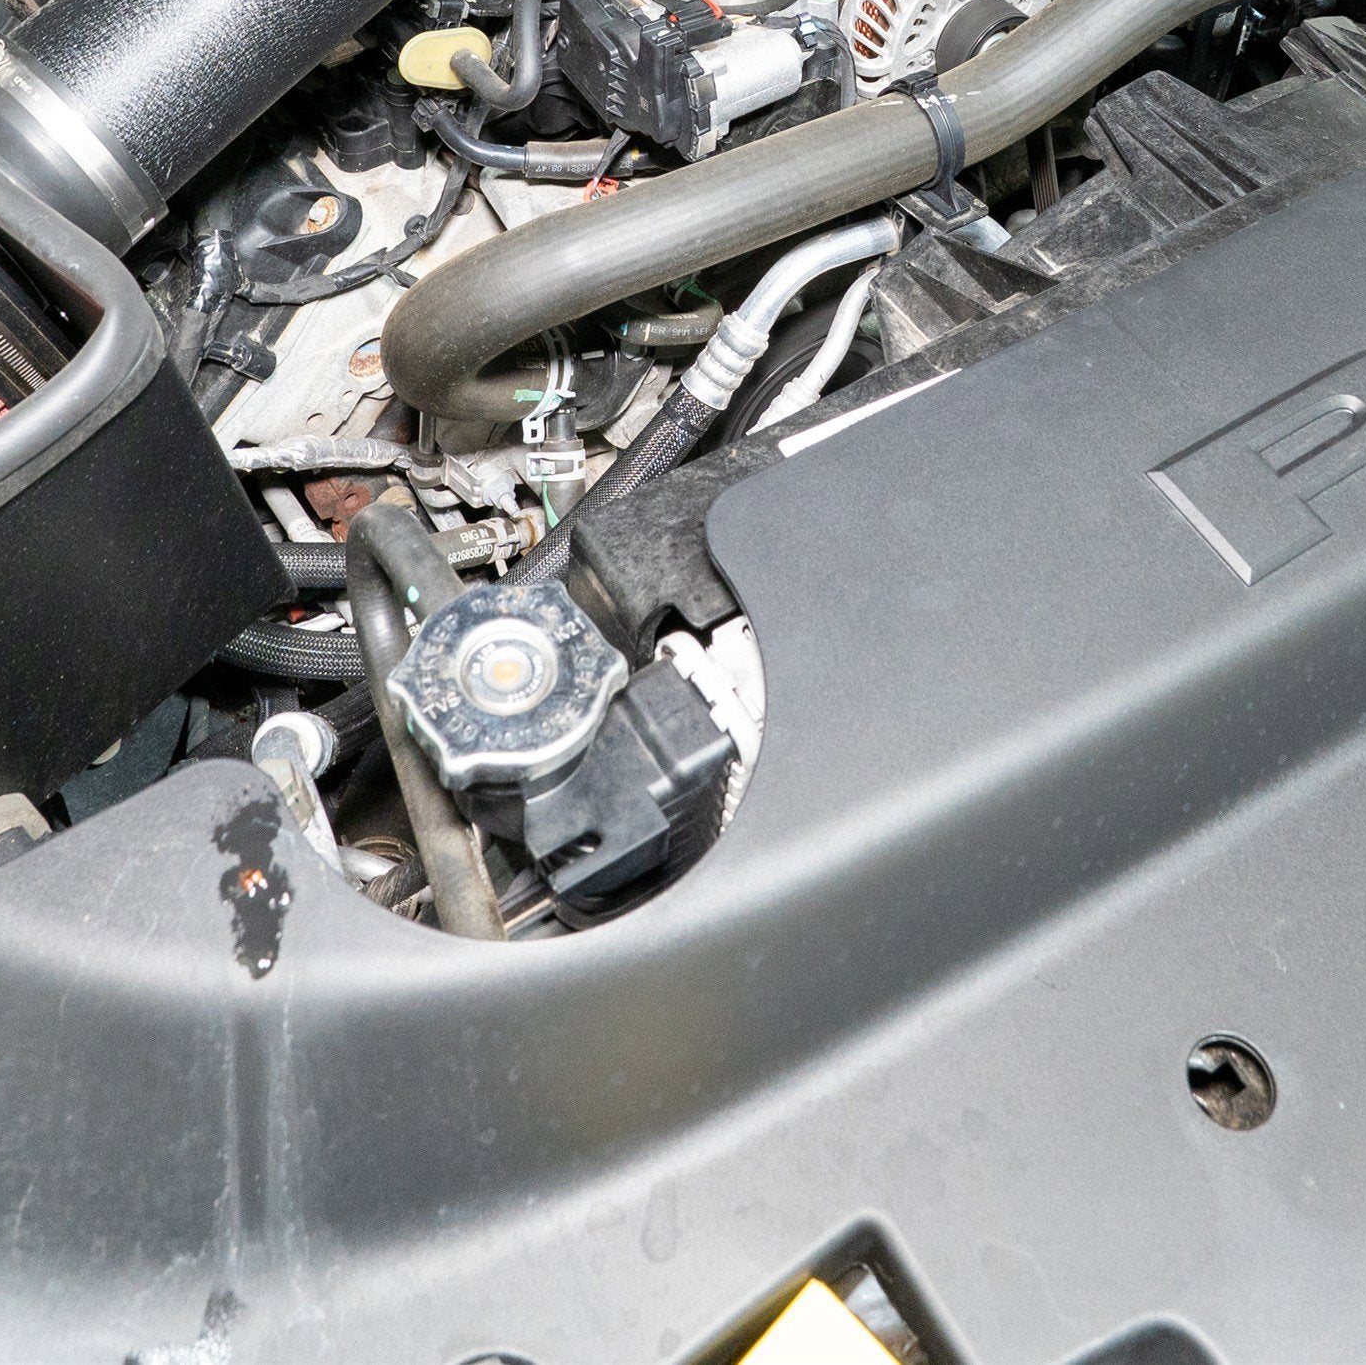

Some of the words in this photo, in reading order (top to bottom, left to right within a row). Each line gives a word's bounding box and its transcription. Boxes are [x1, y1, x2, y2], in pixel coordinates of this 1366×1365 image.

[459, 529, 479, 543] ENG
[478, 527, 490, 539] IN
[447, 543, 494, 565] 68268582AD
[422, 691, 461, 720] TVS
